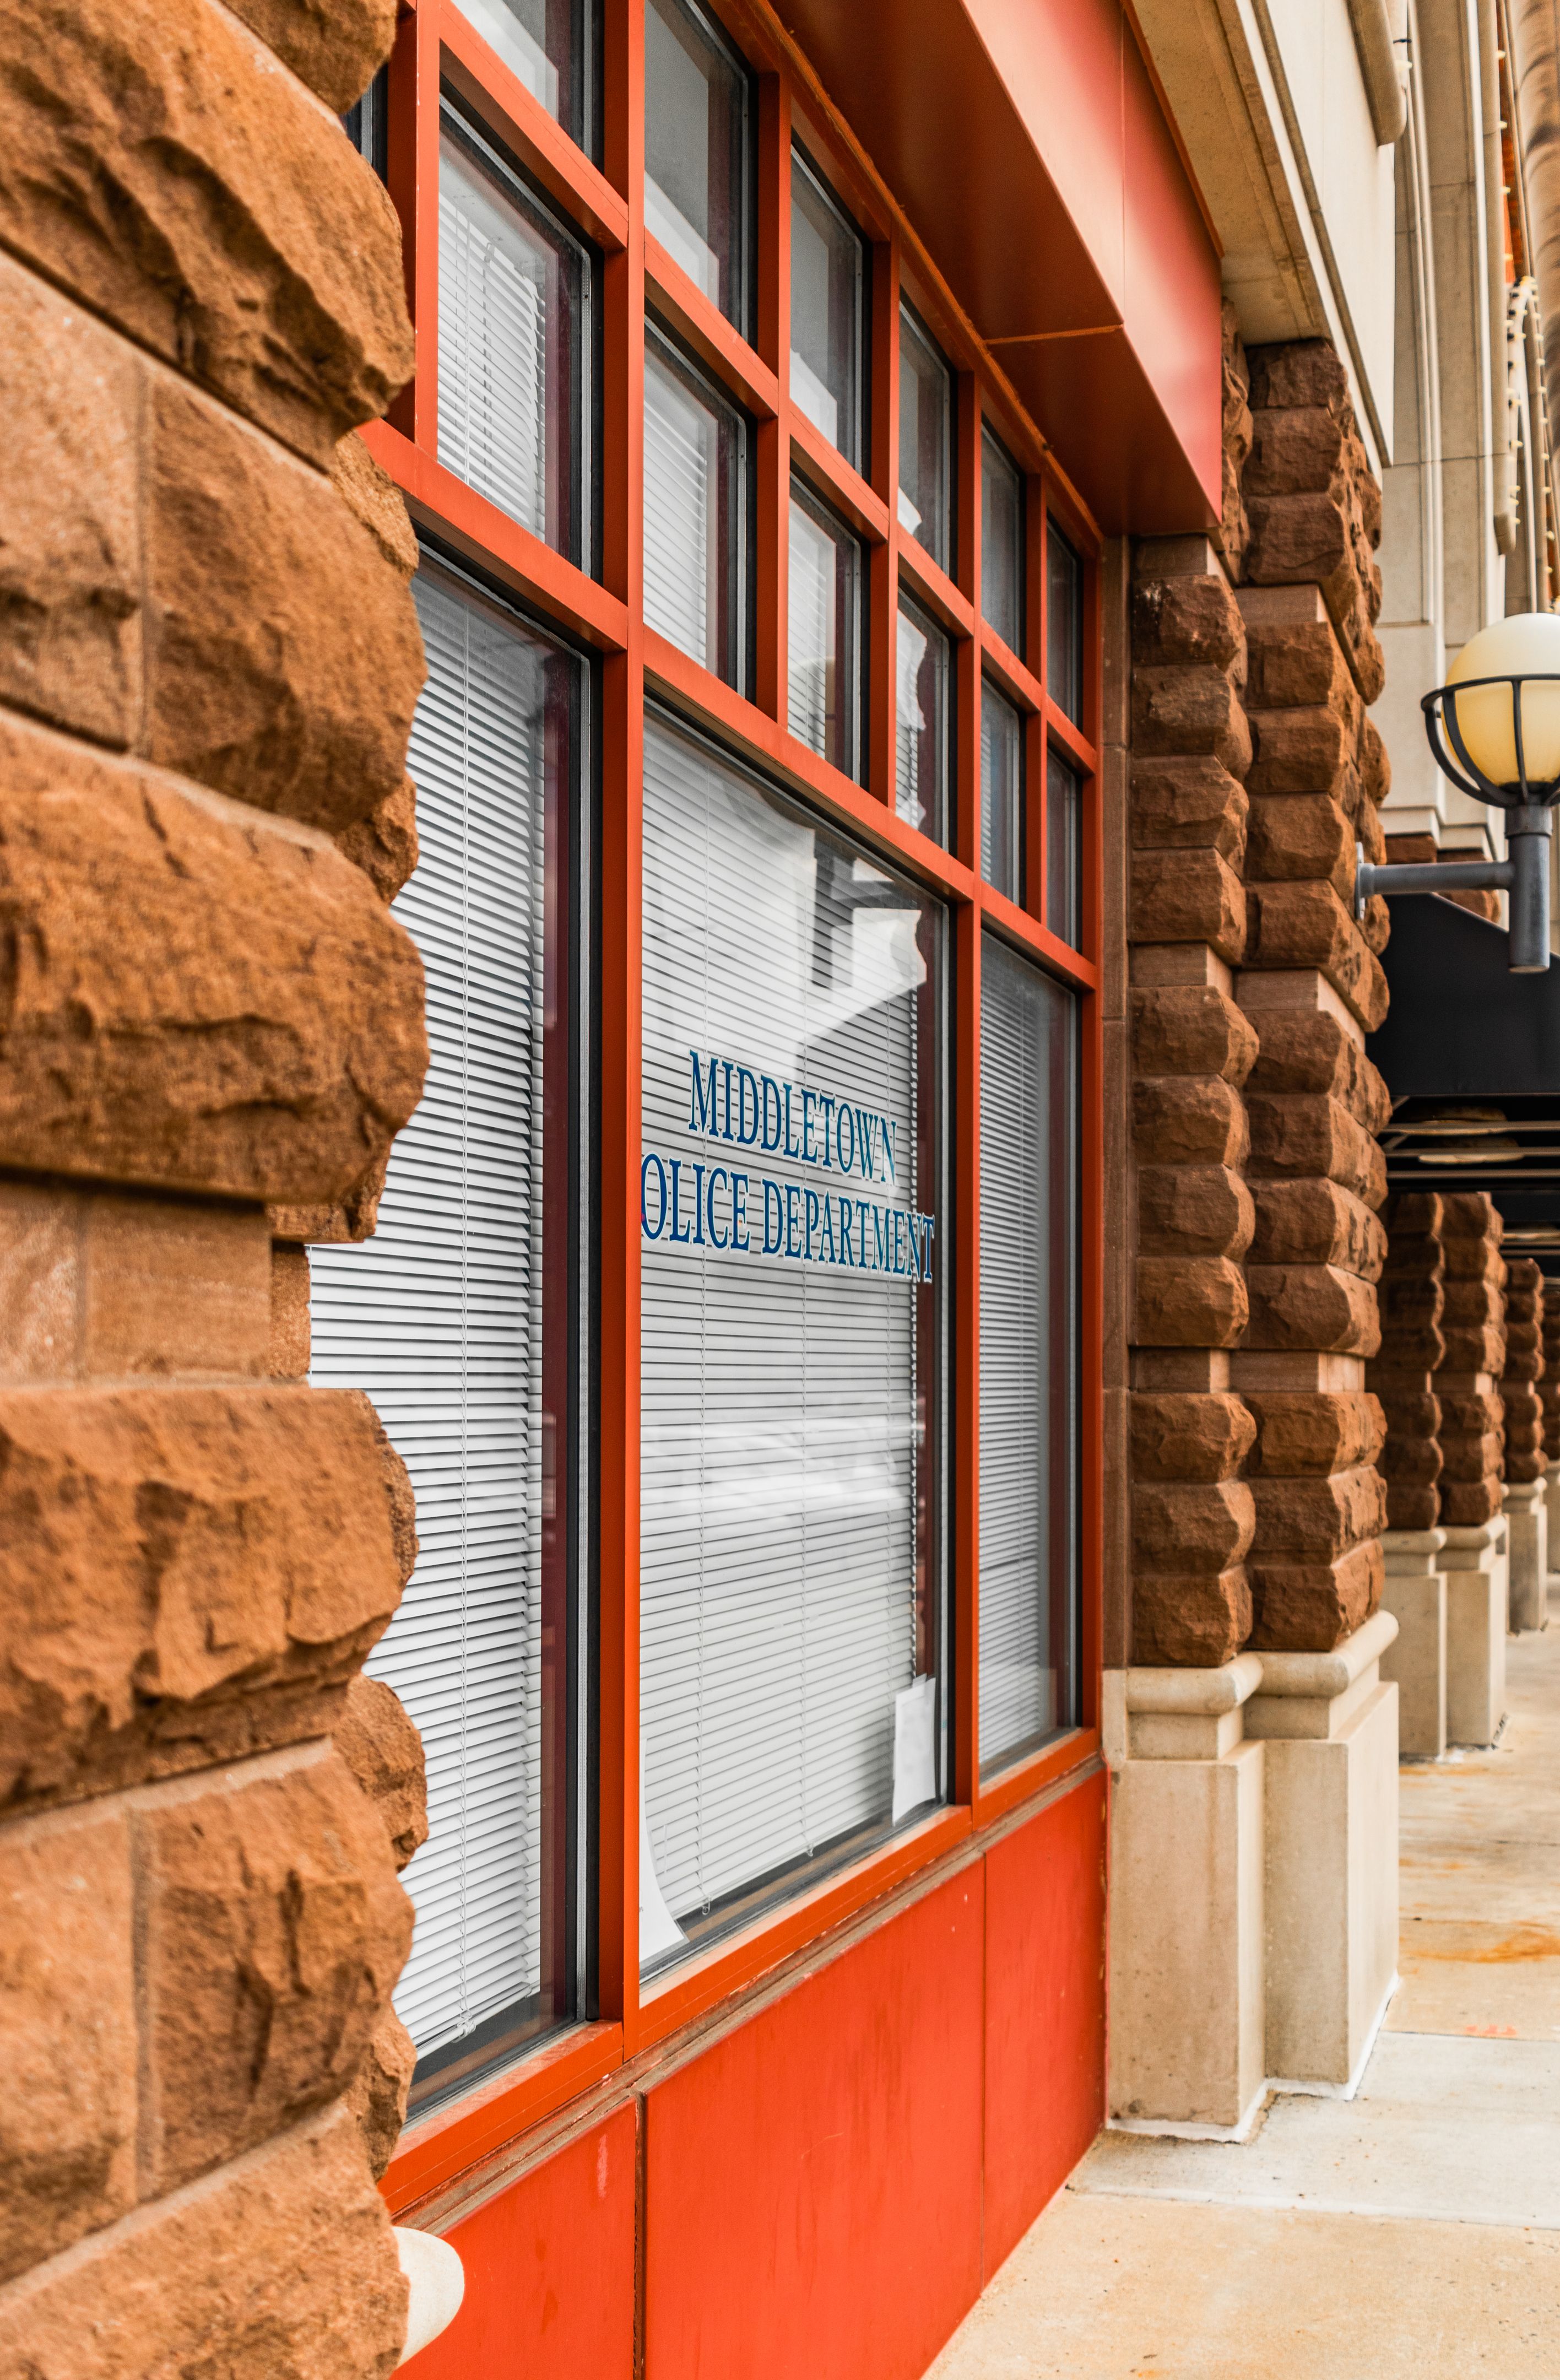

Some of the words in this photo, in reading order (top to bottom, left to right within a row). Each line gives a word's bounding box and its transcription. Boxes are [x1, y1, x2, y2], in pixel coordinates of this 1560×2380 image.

[689, 1049, 897, 1183] MIDDLETOWN
[641, 1154, 750, 1252] OLICE
[761, 1178, 935, 1283] DEPARTMENT
